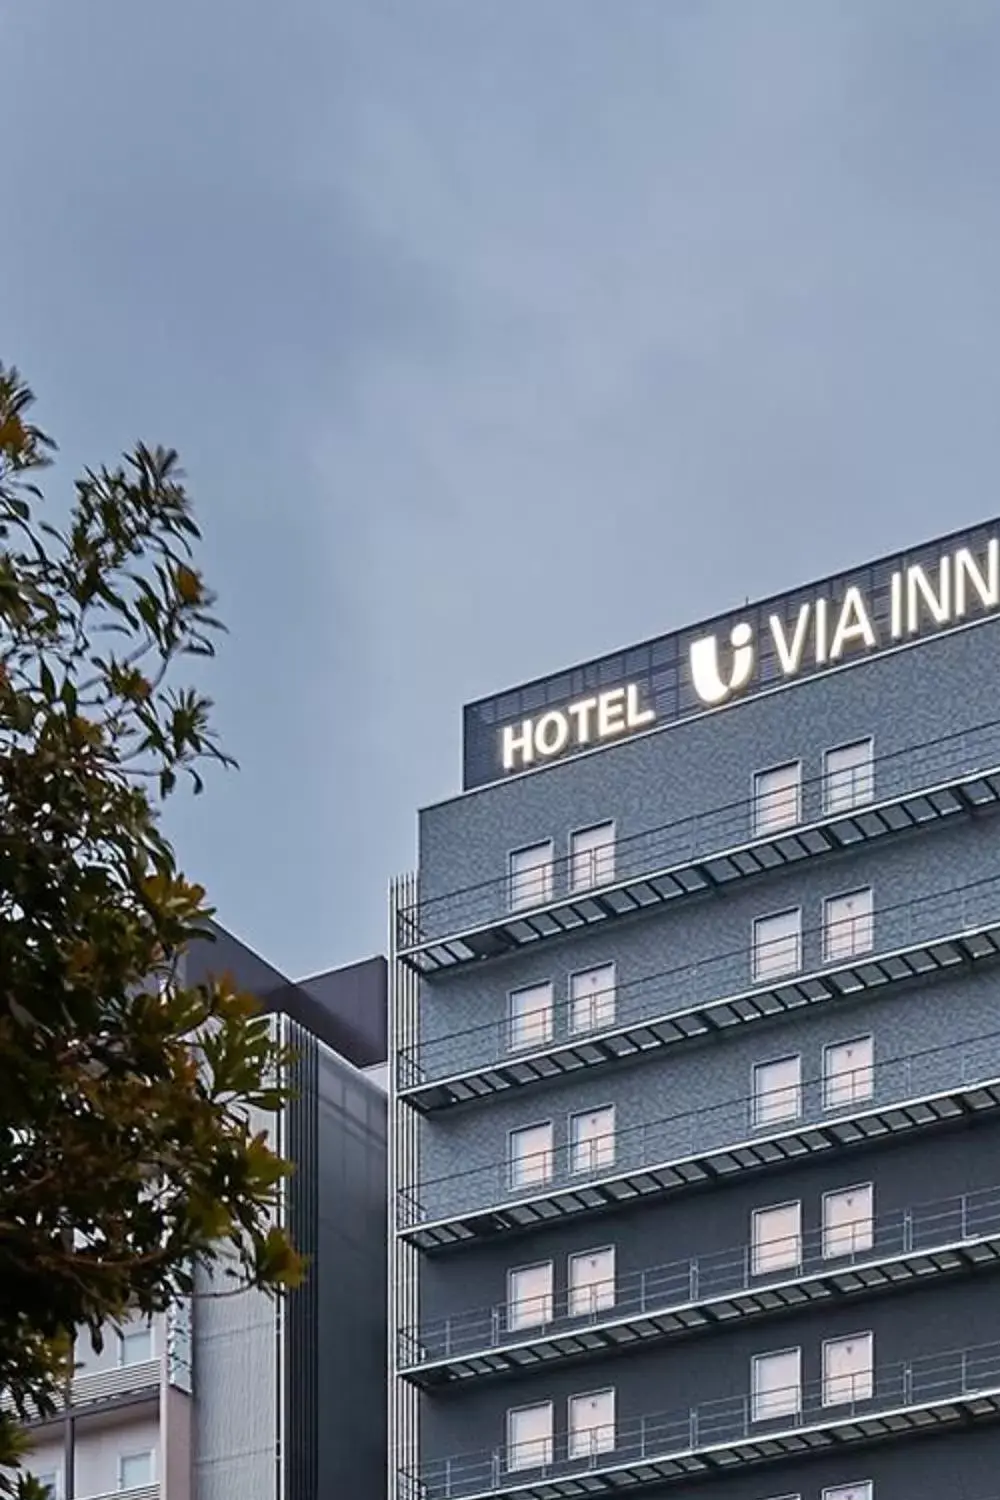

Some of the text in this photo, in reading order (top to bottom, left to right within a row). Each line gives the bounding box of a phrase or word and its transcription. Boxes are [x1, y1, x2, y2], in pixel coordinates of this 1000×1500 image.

[501, 686, 655, 769] HOTEL
[769, 587, 876, 677] VIA
[890, 538, 1000, 641] INN
